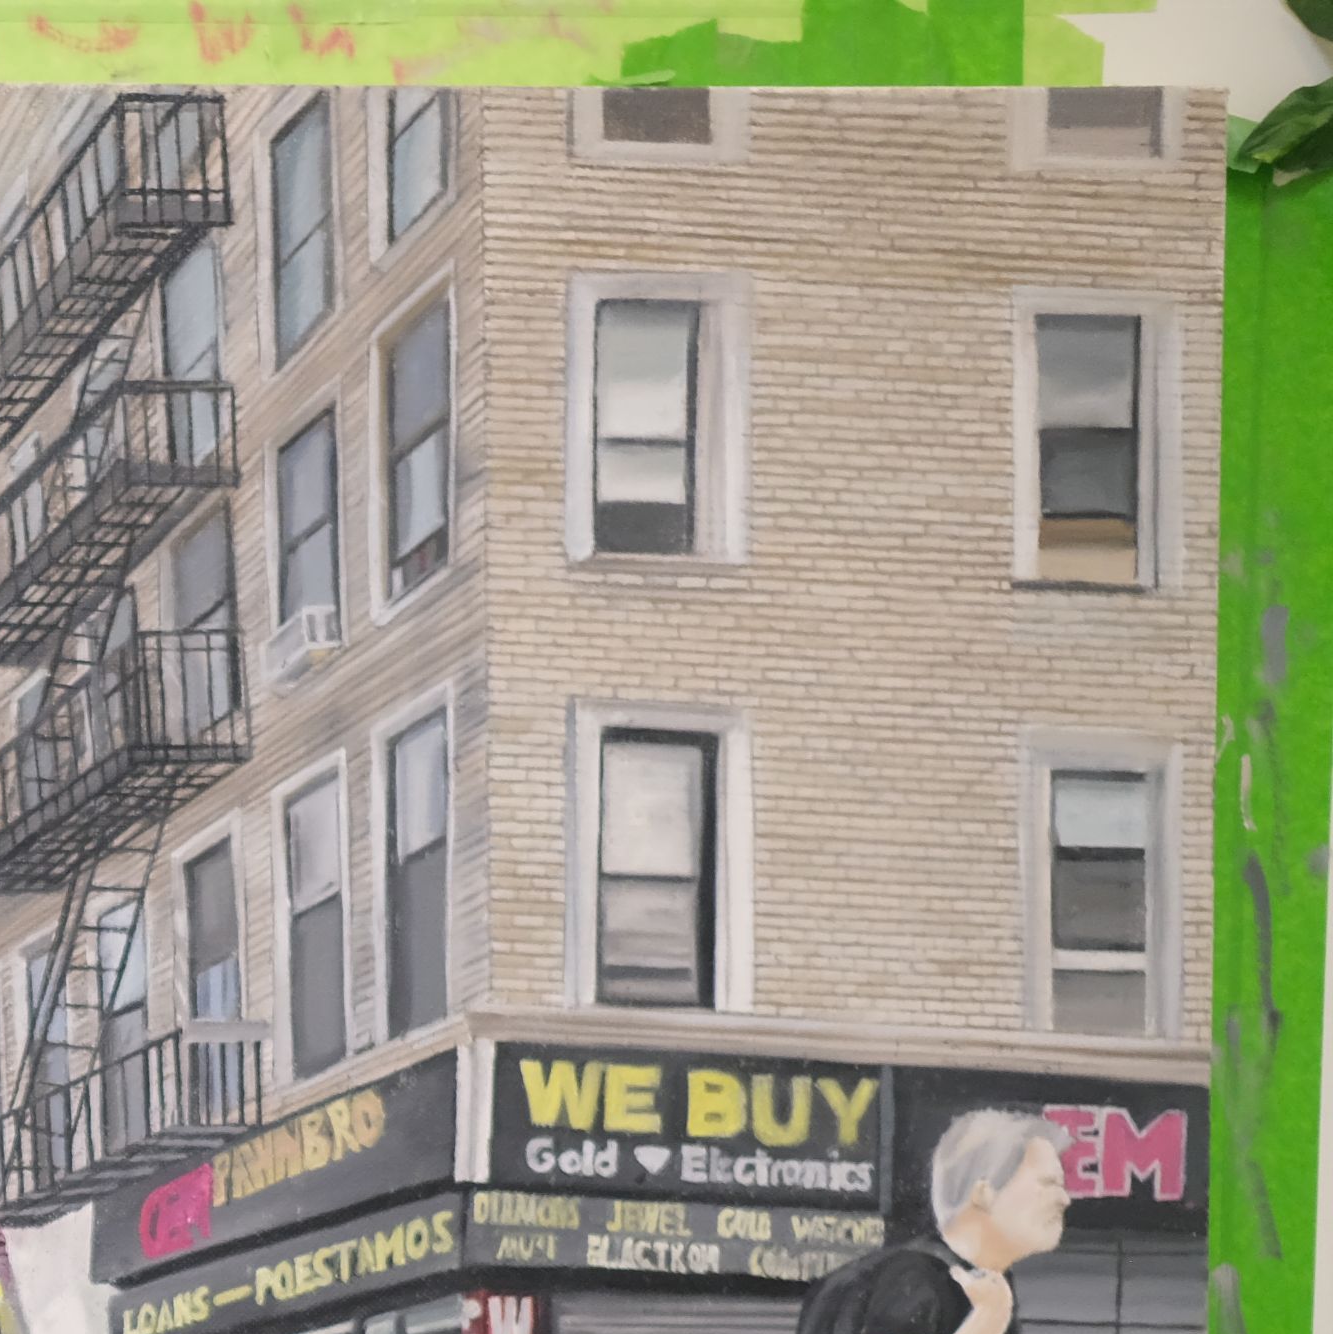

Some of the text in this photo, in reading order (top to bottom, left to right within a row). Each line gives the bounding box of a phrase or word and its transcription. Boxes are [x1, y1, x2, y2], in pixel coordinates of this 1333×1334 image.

[520, 1060, 879, 1148] WE BUY
[526, 1137, 874, 1192] Gold Electronics
